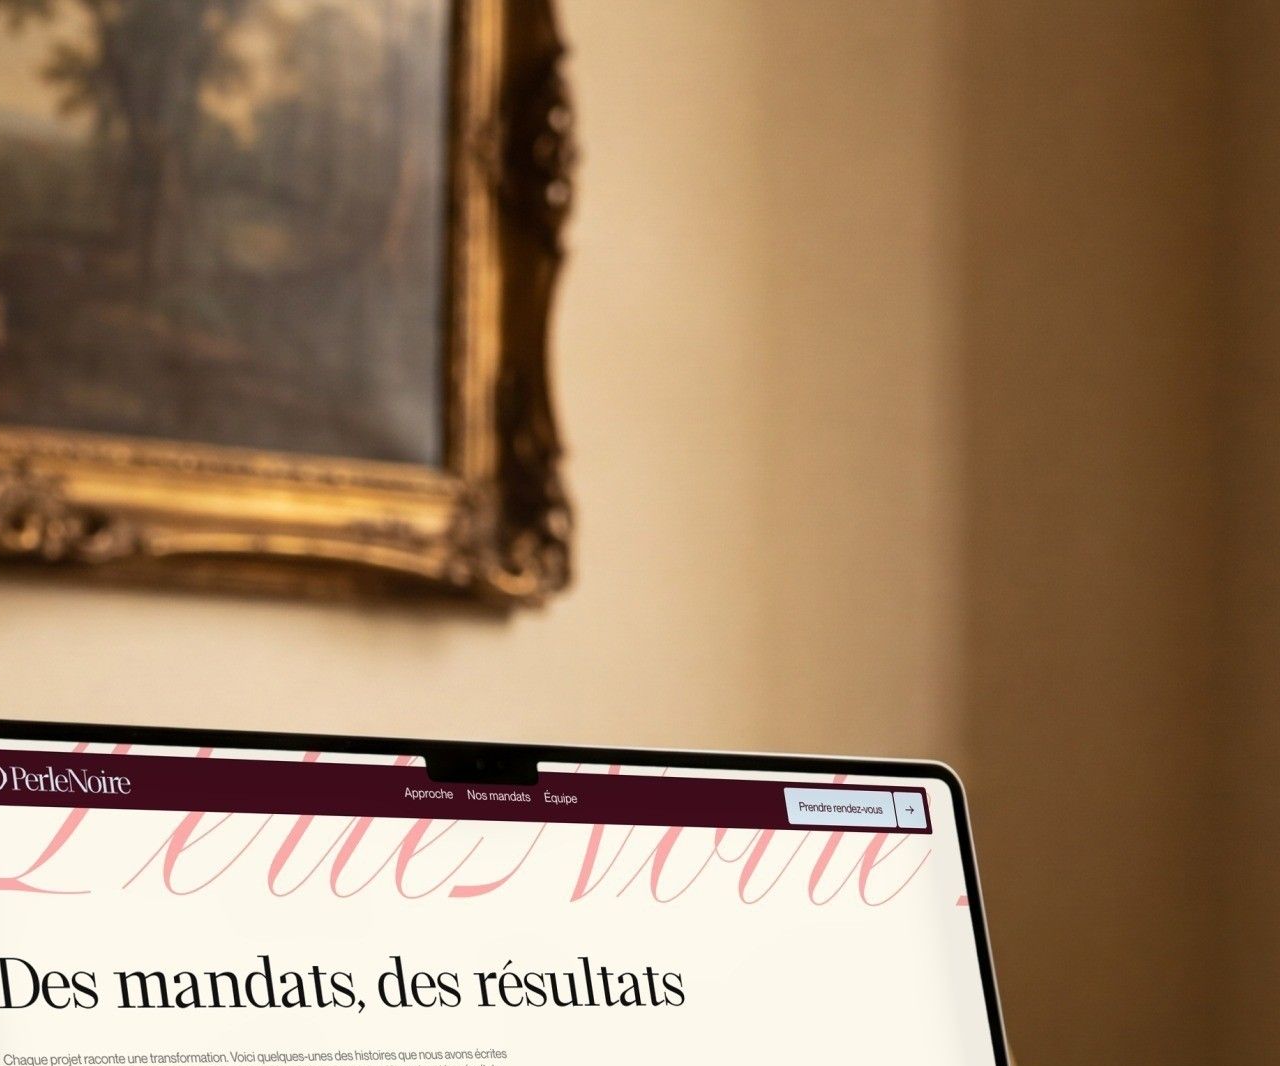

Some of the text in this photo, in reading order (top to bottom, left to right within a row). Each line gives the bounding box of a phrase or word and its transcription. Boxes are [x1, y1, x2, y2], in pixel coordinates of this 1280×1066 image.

[11, 767, 131, 794] PerleNoire
[405, 787, 453, 800] Approche
[467, 790, 531, 802] Nos mandats
[544, 790, 577, 805] Équipe
[799, 802, 883, 814] Prendre rendez-vous
[113, 955, 365, 1013] mandats,
[378, 956, 461, 1007] des
[474, 957, 685, 1007] résultats
[3, 1054, 48, 1066] Chaque
[50, 1054, 82, 1066] projet
[84, 1054, 125, 1064] raconte
[128, 1056, 148, 1064] une
[150, 1052, 229, 1063] transformation.
[230, 1052, 255, 1062] Voici
[257, 1051, 333, 1064] quelques-unes
[335, 1051, 353, 1061] des
[355, 1050, 397, 1060] histoires
[398, 1052, 417, 1062] que
[445, 1051, 473, 1059] avons
[475, 1049, 507, 1059] écrites
